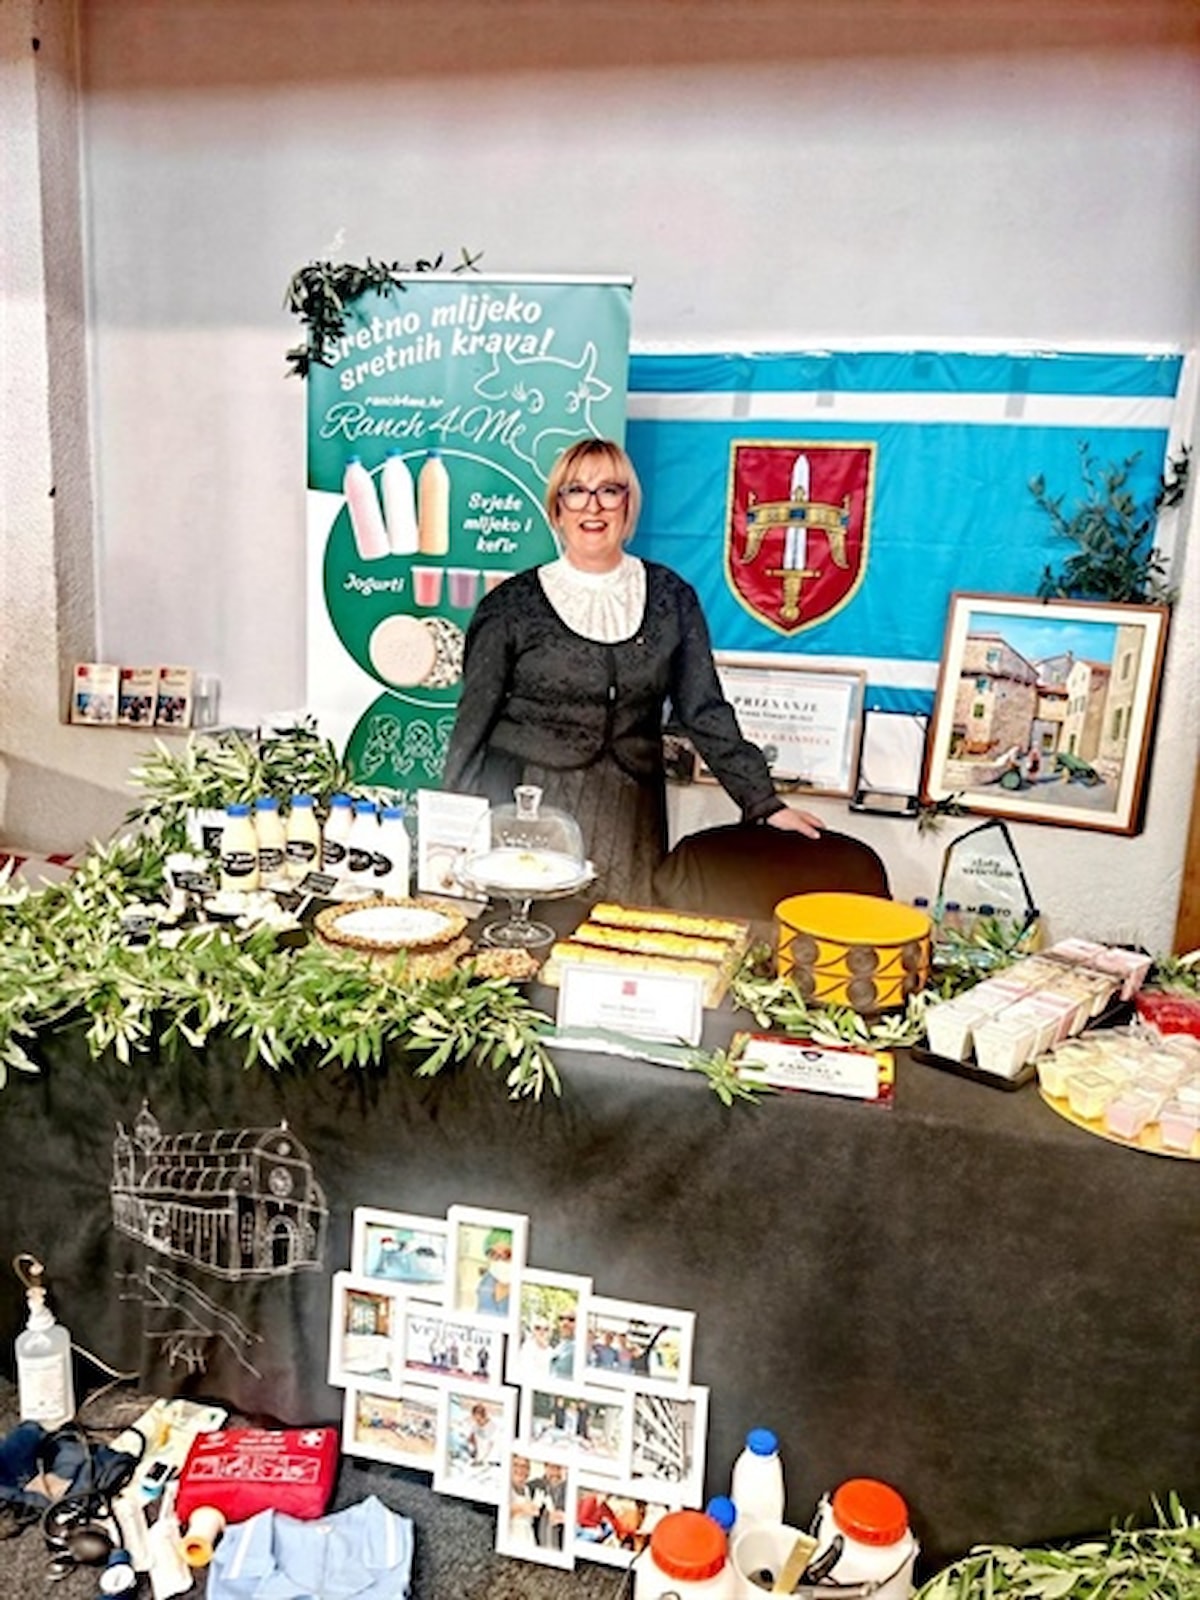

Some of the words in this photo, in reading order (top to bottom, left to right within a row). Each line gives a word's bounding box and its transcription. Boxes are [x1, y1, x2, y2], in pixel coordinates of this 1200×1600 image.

[431, 292, 542, 332] mlijeko
[340, 332, 442, 391] sretnih
[452, 327, 556, 357] krava!
[319, 402, 425, 441] Ranch
[429, 405, 461, 442] 4
[461, 405, 526, 445] Me
[463, 515, 521, 535] mlijeko
[476, 536, 518, 553] kefir
[343, 572, 405, 596] Jogurti
